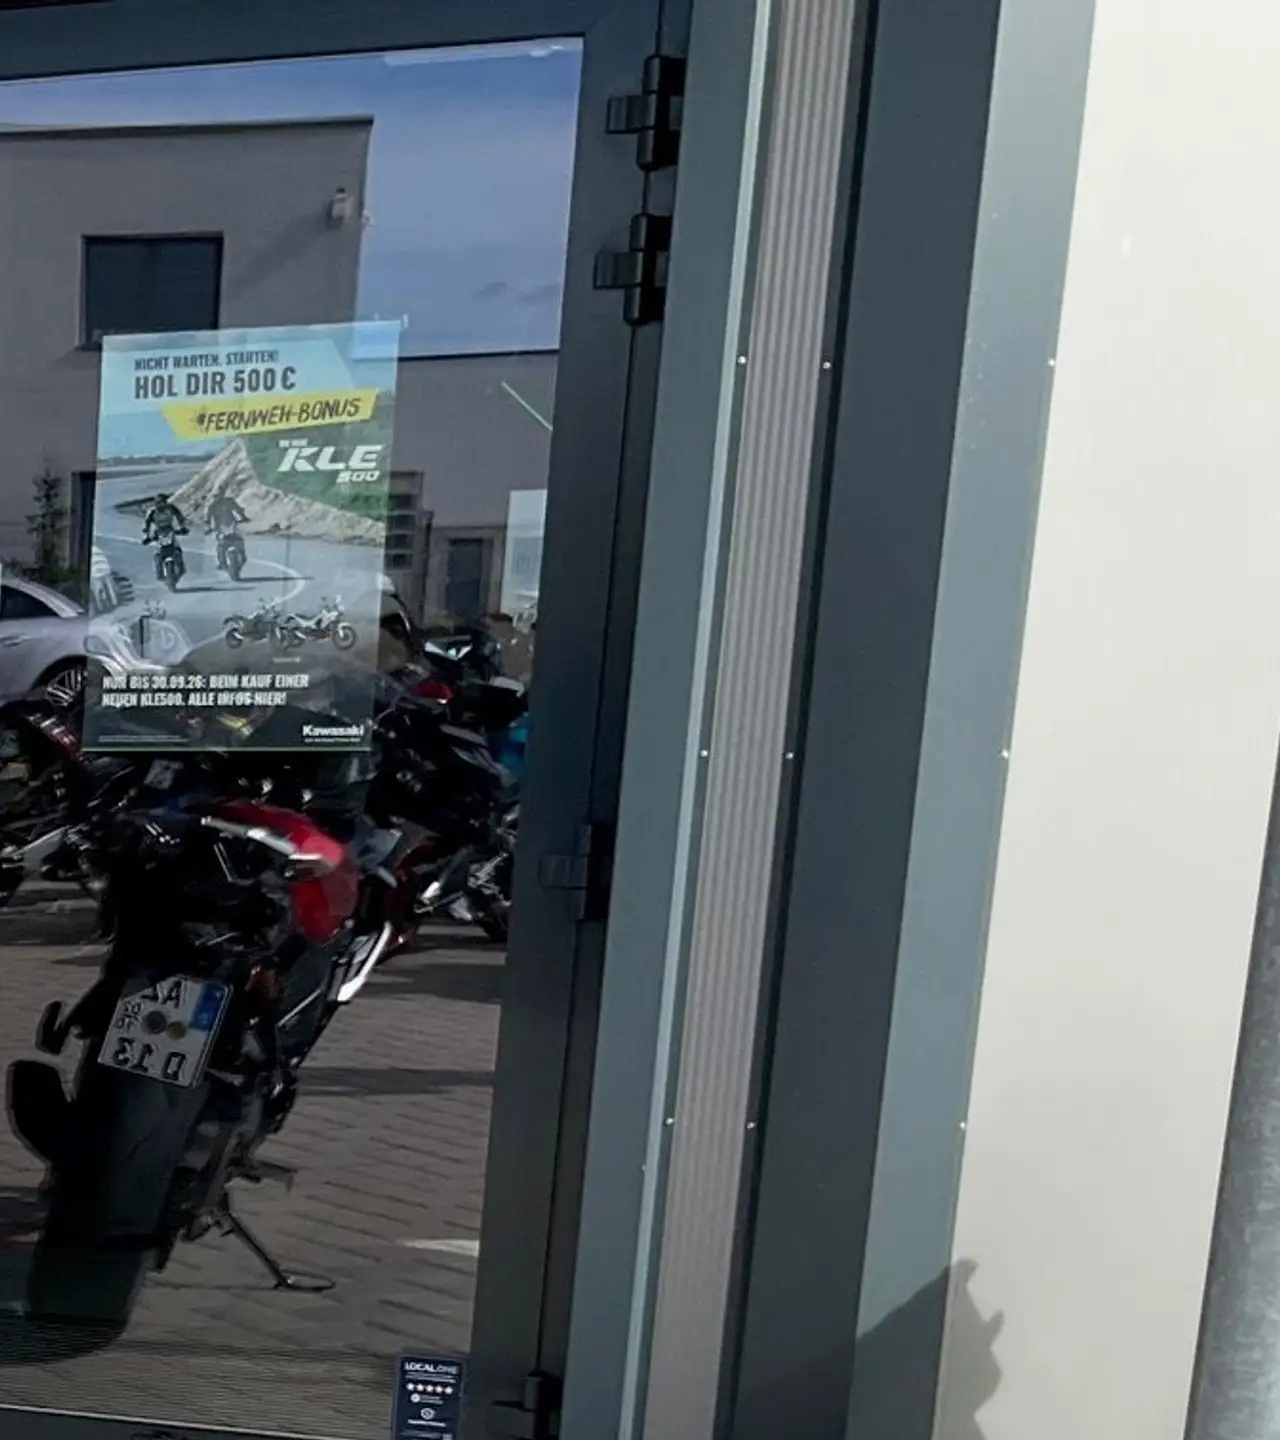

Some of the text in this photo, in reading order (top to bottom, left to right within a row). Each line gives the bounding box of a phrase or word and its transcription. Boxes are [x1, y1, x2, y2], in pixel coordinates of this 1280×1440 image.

[134, 356, 169, 371] NICHT
[134, 366, 297, 400] HOL DIR 500 €
[277, 444, 383, 472] KLE
[241, 674, 272, 688] KAUF
[274, 674, 310, 688] EINER
[188, 692, 215, 706] ALLE
[302, 724, 365, 737] Kawasaki
